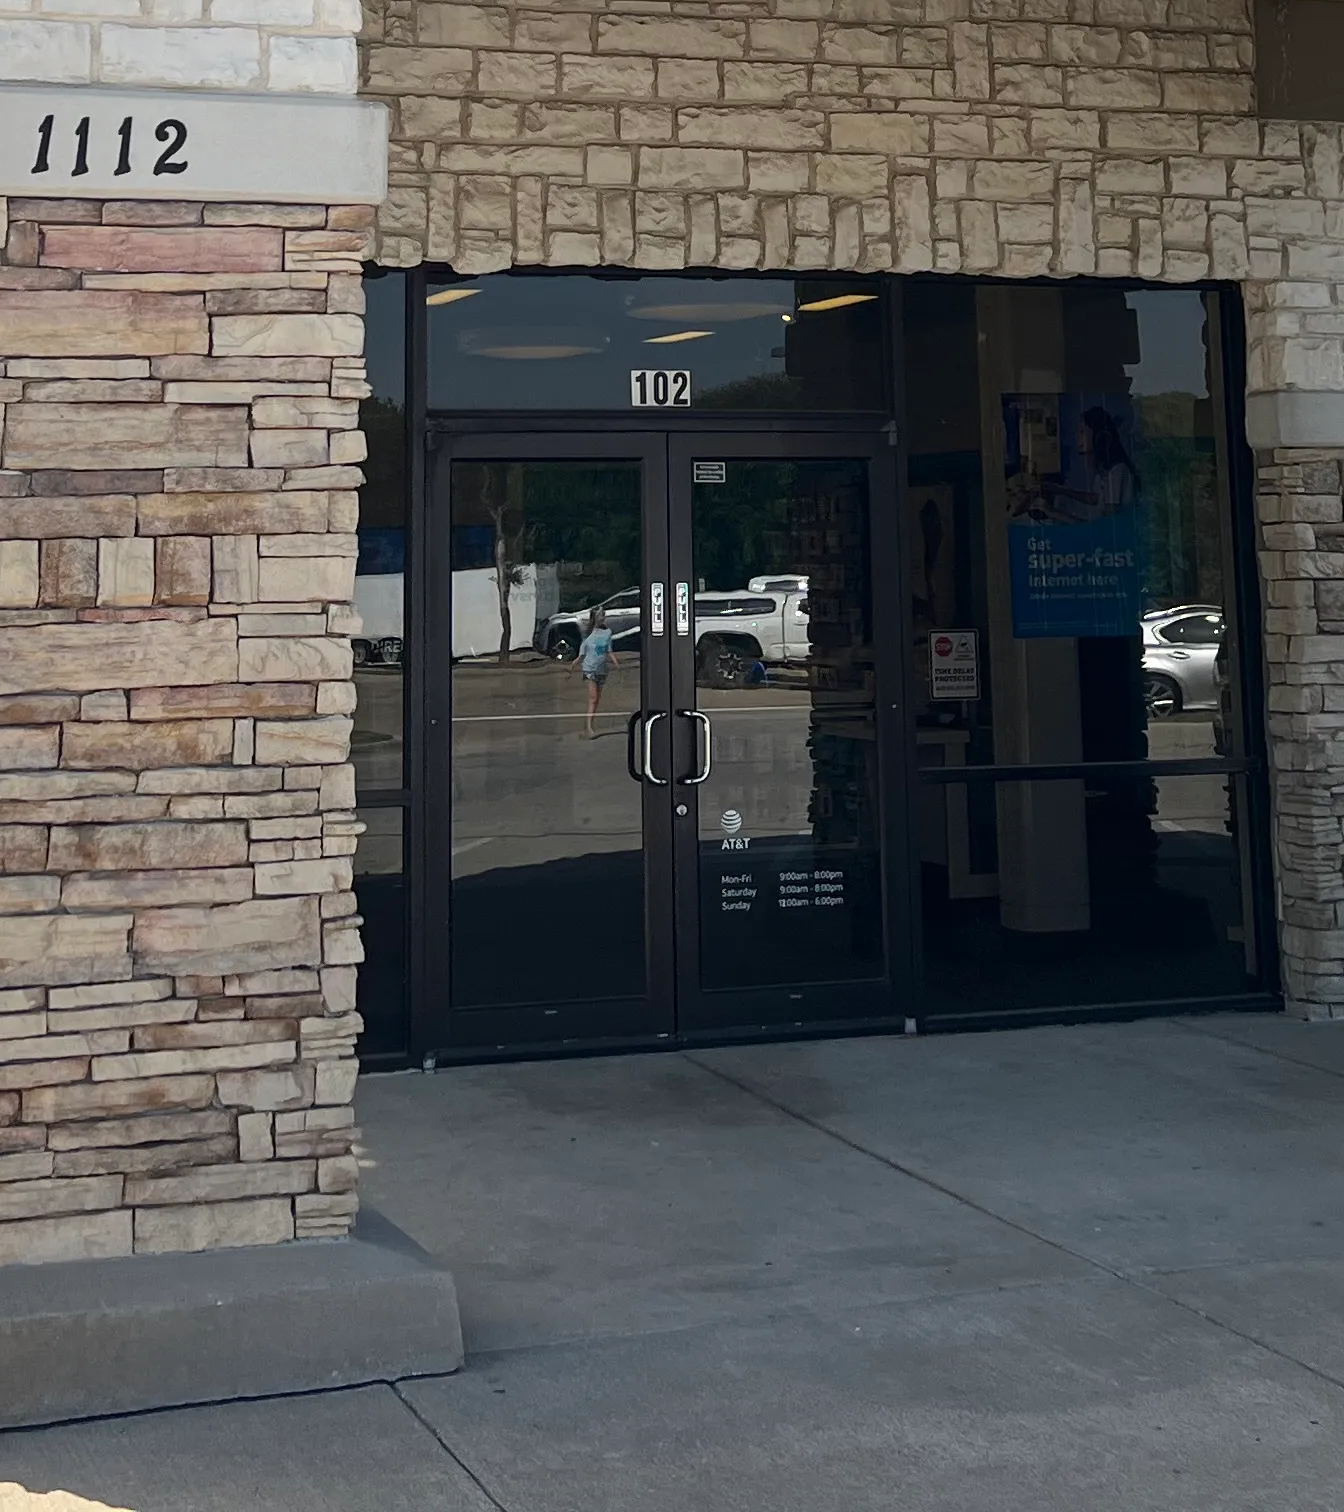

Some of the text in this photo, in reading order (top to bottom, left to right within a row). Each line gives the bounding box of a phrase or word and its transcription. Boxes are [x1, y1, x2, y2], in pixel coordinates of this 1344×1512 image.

[31, 114, 188, 176] 1112
[635, 372, 688, 405] 102
[1027, 536, 1052, 551] Get
[1028, 547, 1135, 574] super-fast
[1087, 572, 1119, 586] here
[654, 587, 662, 622] PULL
[678, 587, 687, 622] PULL
[721, 837, 751, 850] AT&T
[721, 874, 752, 884] Mon-Fri
[779, 872, 808, 881] 9:00am
[814, 870, 843, 880] 8:00pm
[721, 888, 757, 897] Saturday
[779, 886, 809, 895] 9:00am
[814, 884, 844, 893] 8:00pm
[721, 901, 752, 911] Sunday
[814, 896, 844, 906] 6:00pm
